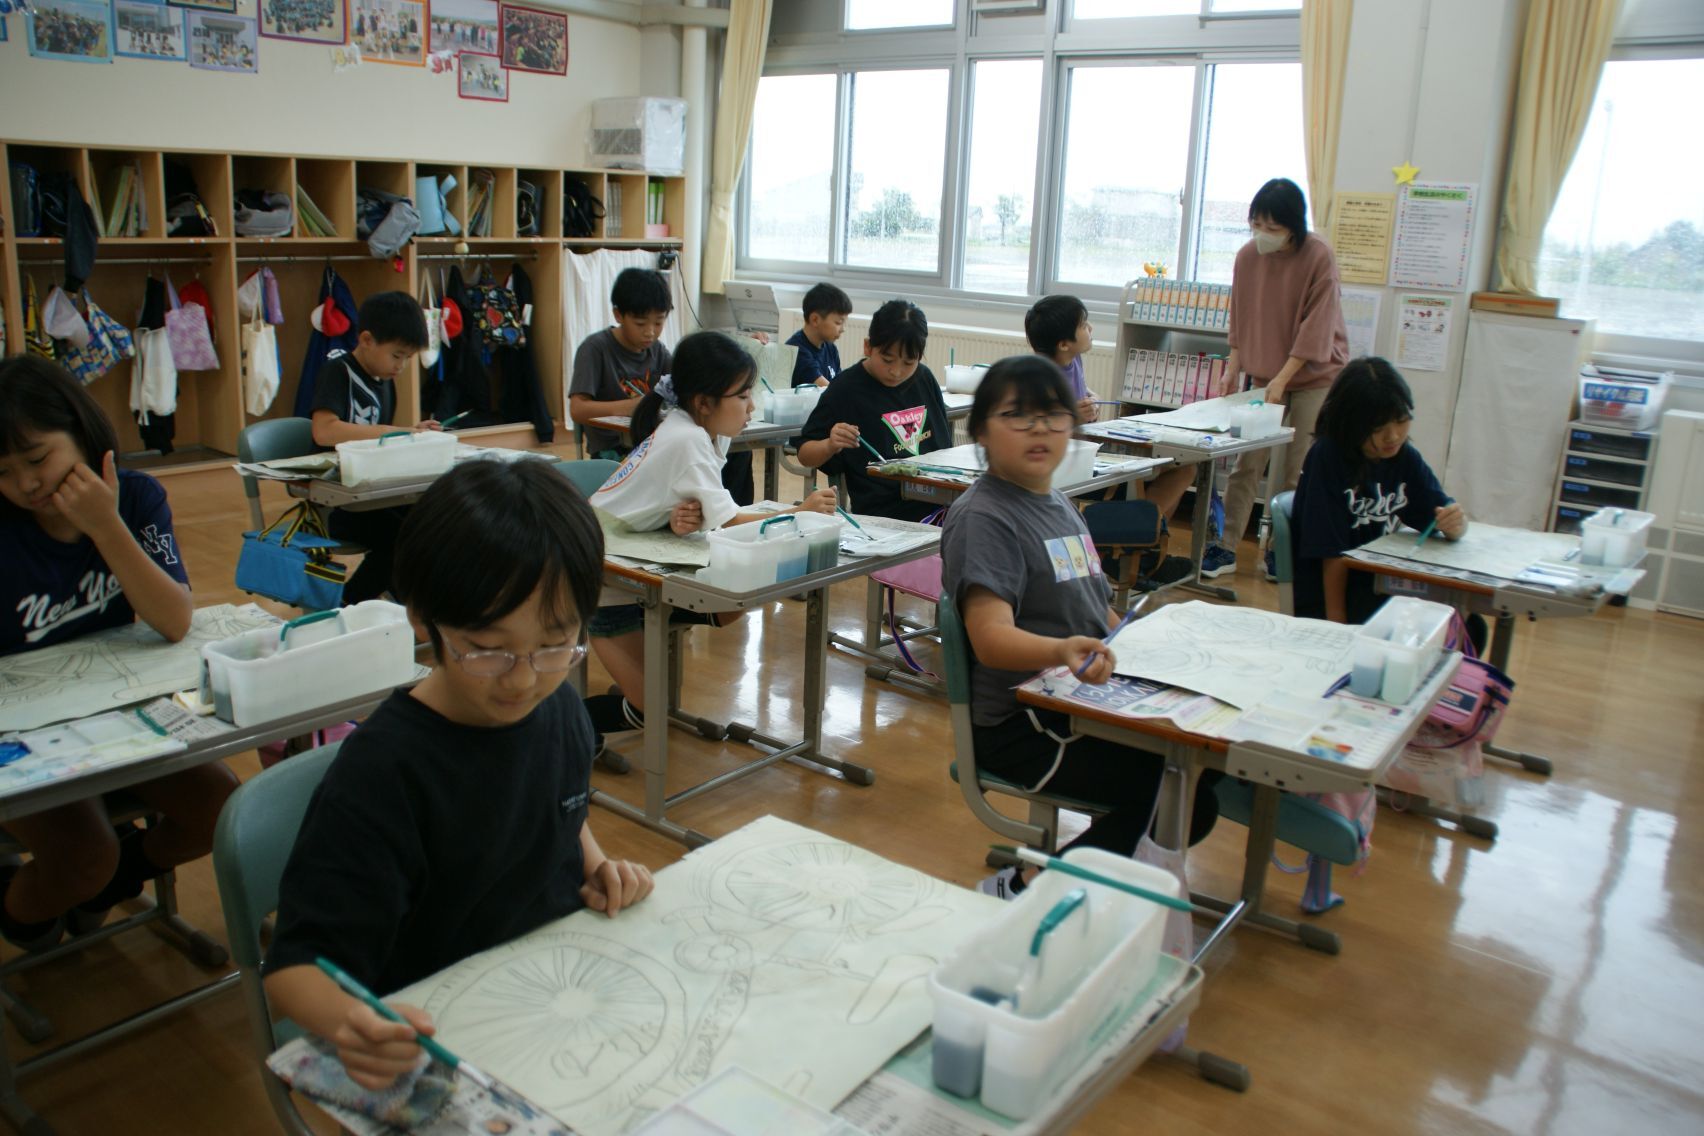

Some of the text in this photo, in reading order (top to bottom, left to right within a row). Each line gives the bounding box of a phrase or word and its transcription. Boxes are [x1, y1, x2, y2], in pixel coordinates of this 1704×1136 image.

[890, 411, 923, 425] Oakley
[16, 569, 123, 629] New Yo
